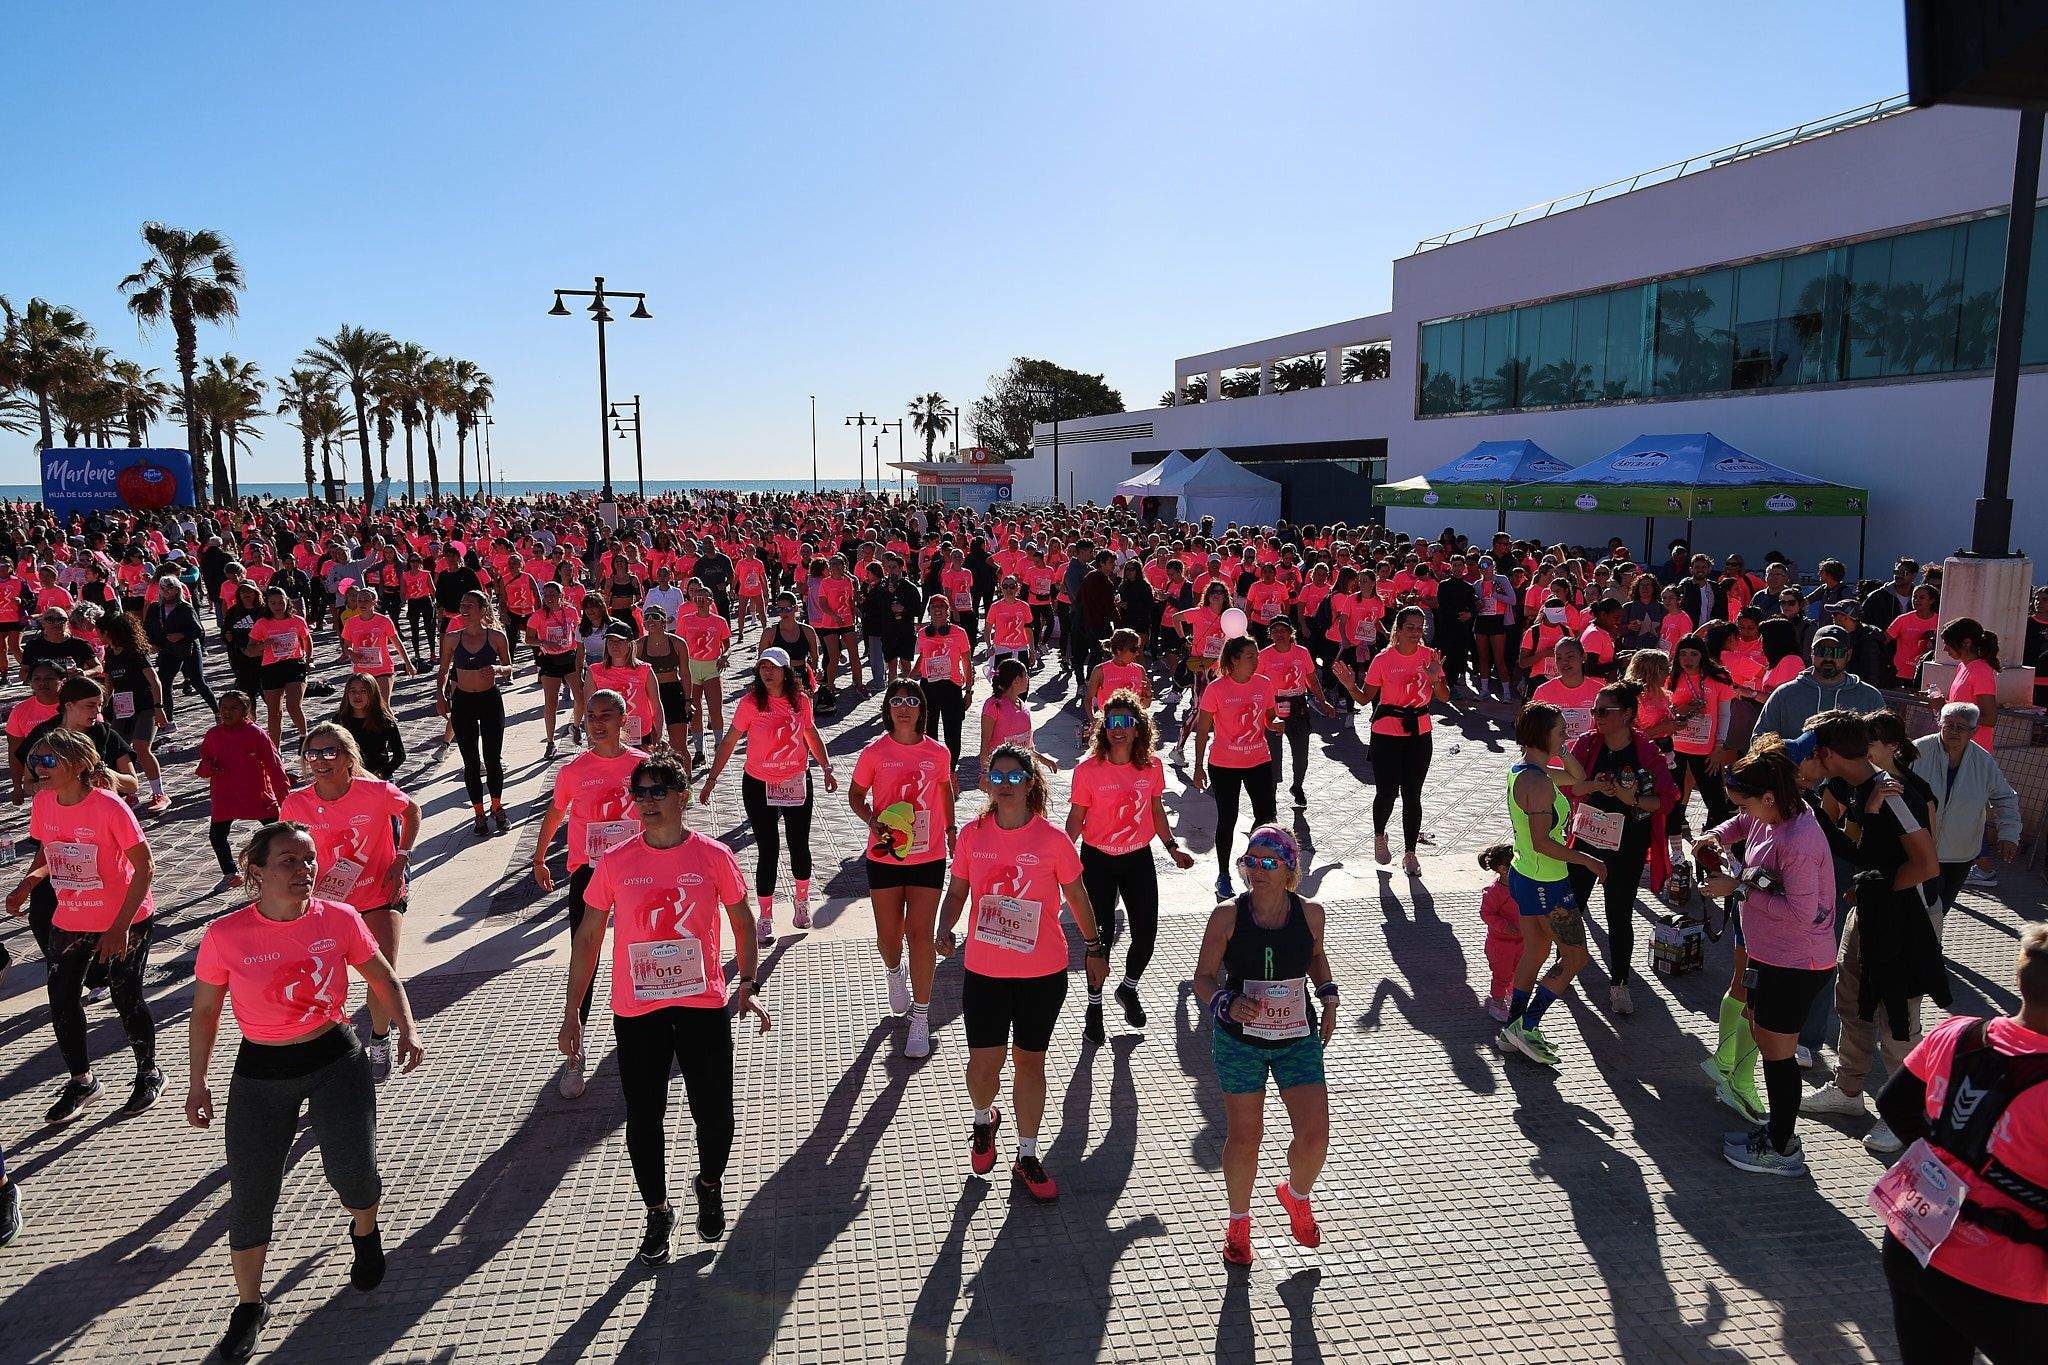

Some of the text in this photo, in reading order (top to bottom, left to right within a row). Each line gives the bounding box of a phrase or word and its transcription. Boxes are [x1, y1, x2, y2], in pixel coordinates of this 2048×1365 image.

[1590, 825, 1607, 835] 016
[972, 851, 997, 859] OYSHO
[66, 863, 83, 874] 016
[324, 875, 346, 887] 016
[355, 876, 375, 888] MUJER
[623, 876, 653, 886] OYSHO
[75, 900, 83, 908] LA
[83, 899, 104, 907] MUJER
[999, 916, 1020, 930] 016
[244, 952, 280, 965] OYSHO
[656, 965, 683, 978] 016
[1267, 1006, 1291, 1017] 016
[1906, 1188, 1931, 1217] 016
